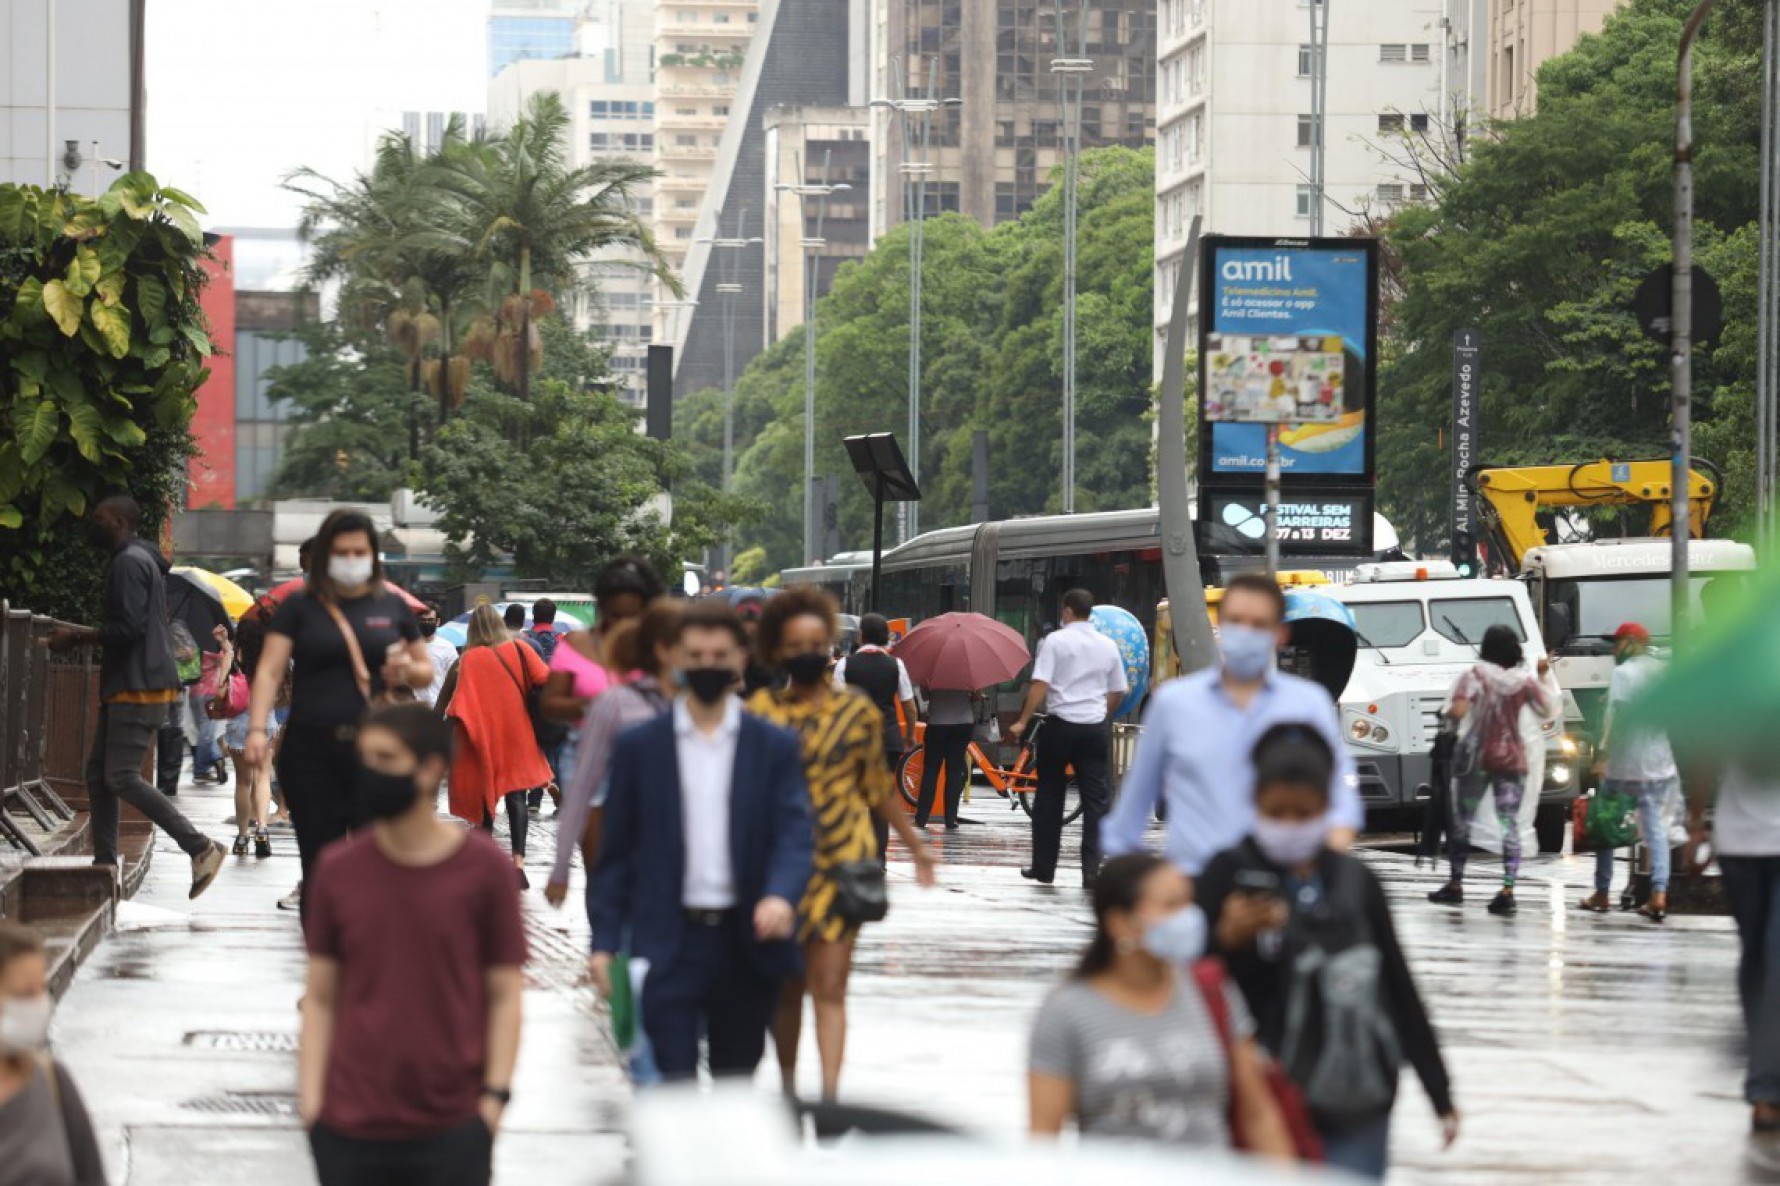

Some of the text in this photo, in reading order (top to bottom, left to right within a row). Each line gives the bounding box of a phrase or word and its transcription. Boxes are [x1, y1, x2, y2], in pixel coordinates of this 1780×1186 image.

[1222, 255, 1292, 281] amil
[1244, 299, 1283, 308] acessar
[1285, 300, 1292, 308] o
[1294, 300, 1316, 310] app
[1221, 308, 1246, 319] Amil
[1457, 364, 1472, 427] Azevedo
[1260, 503, 1352, 516] FSTIVAL SEM
[1301, 528, 1316, 539] 13
[1321, 528, 1352, 541] DEZ
